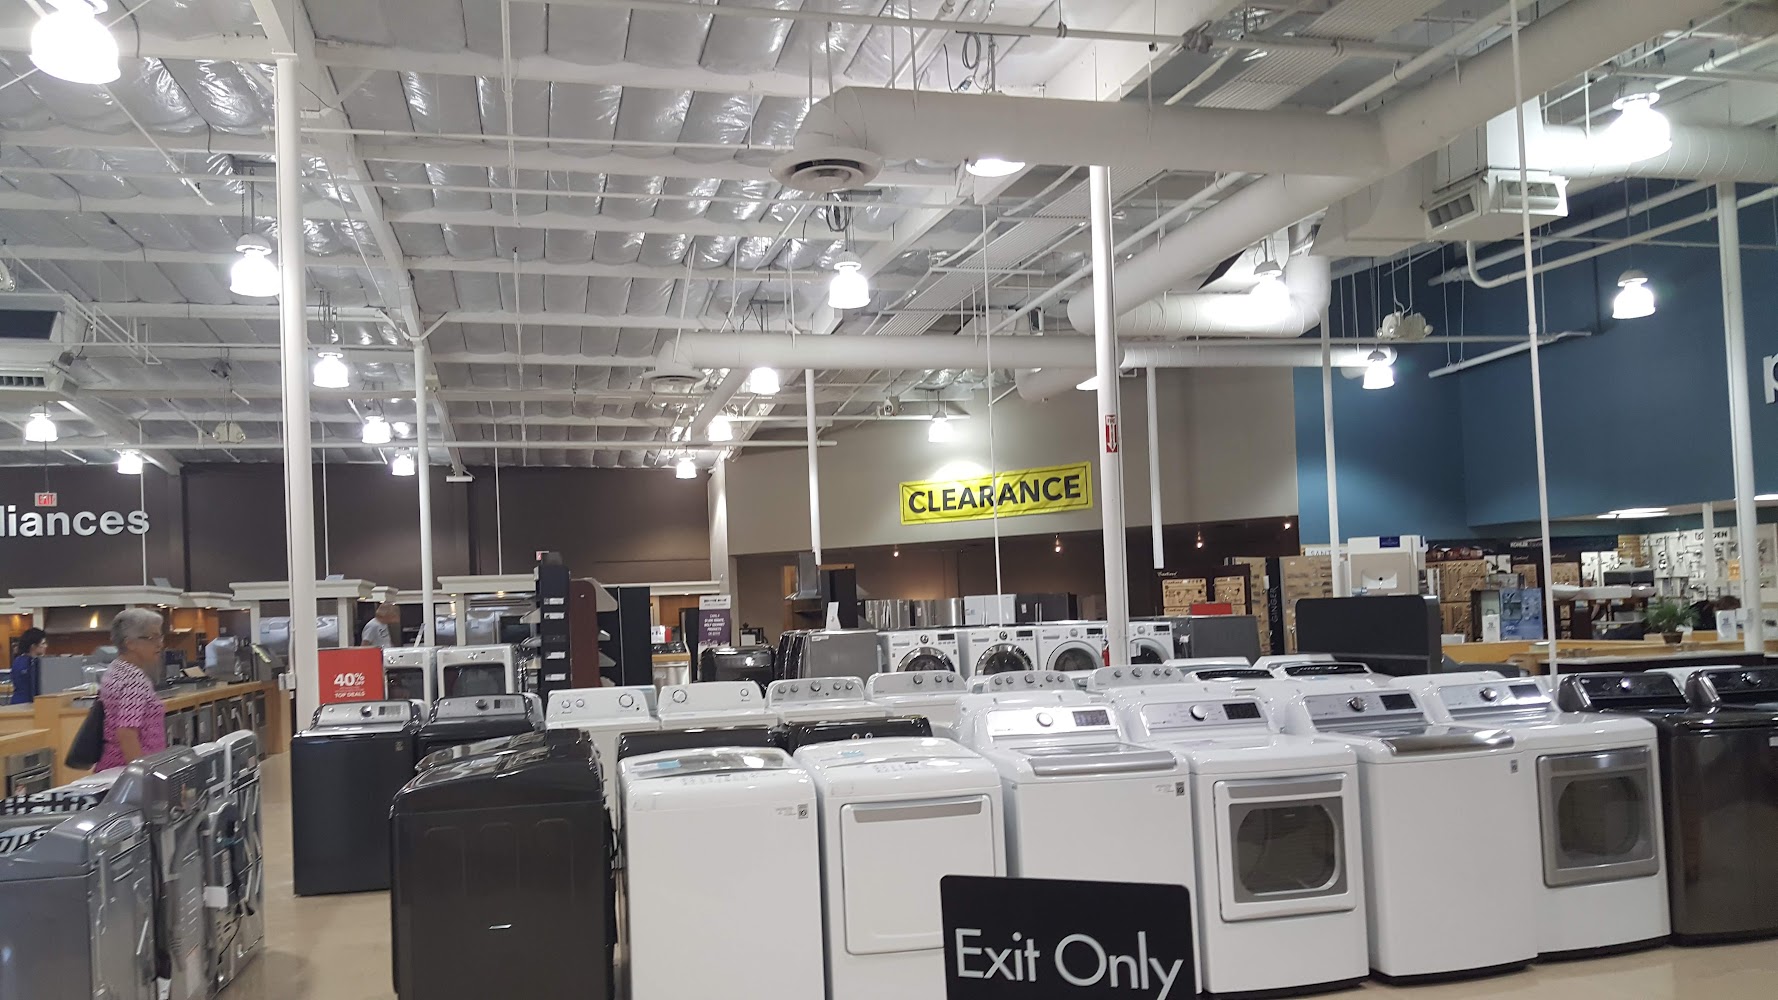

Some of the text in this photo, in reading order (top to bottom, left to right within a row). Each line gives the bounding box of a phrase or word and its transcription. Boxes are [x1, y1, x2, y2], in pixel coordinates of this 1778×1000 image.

[38, 494, 54, 505] EXIT
[908, 474, 1081, 514] CLEARANCE
[1271, 586, 1279, 623] GINGER
[333, 673, 365, 686] 40%
[954, 927, 1185, 1000] Exit Only
